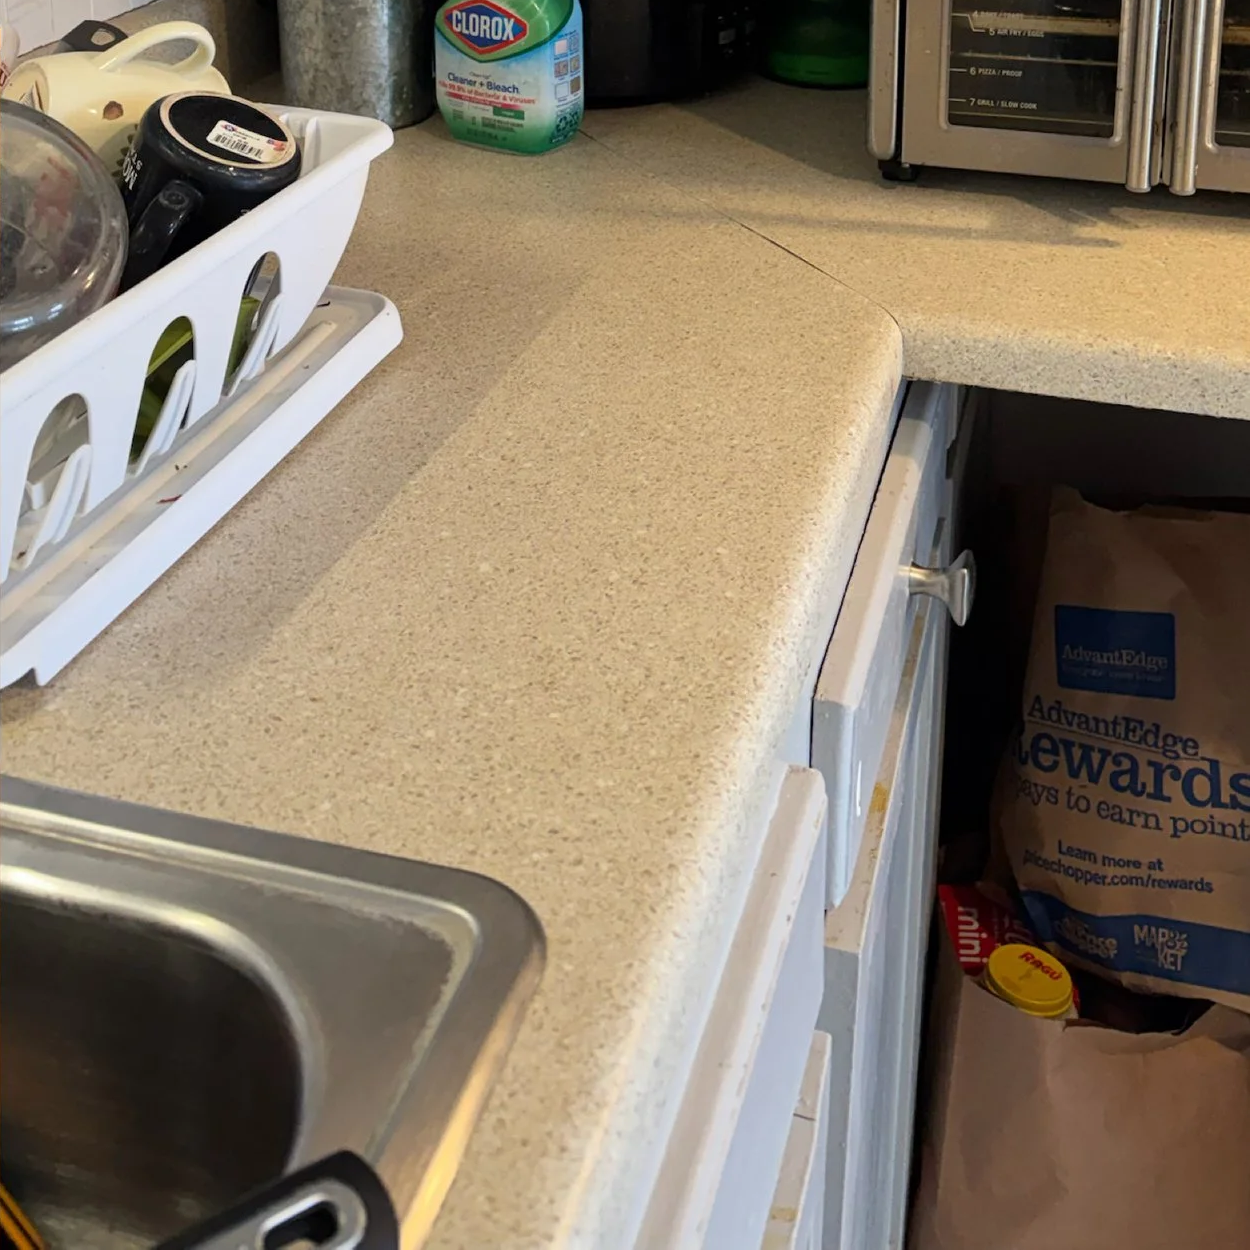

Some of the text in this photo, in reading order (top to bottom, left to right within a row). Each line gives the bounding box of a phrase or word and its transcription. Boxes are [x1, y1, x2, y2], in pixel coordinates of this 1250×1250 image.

[451, 10, 515, 41] CLOROX
[447, 71, 477, 87] Cleaner
[486, 81, 520, 94] Bleach
[969, 67, 976, 76] 6
[978, 68, 996, 76] PIZZA
[969, 97, 1037, 110] 7 GRILL SLOW COOK
[1061, 645, 1169, 672] AdvantEdge
[1027, 695, 1200, 760] AdvantEdge
[1065, 786, 1091, 814] to
[1096, 800, 1163, 831] earn
[1022, 849, 1215, 893] pricechopper.com/rewards
[1057, 840, 1164, 872] Learn more at
[957, 905, 989, 964] mini
